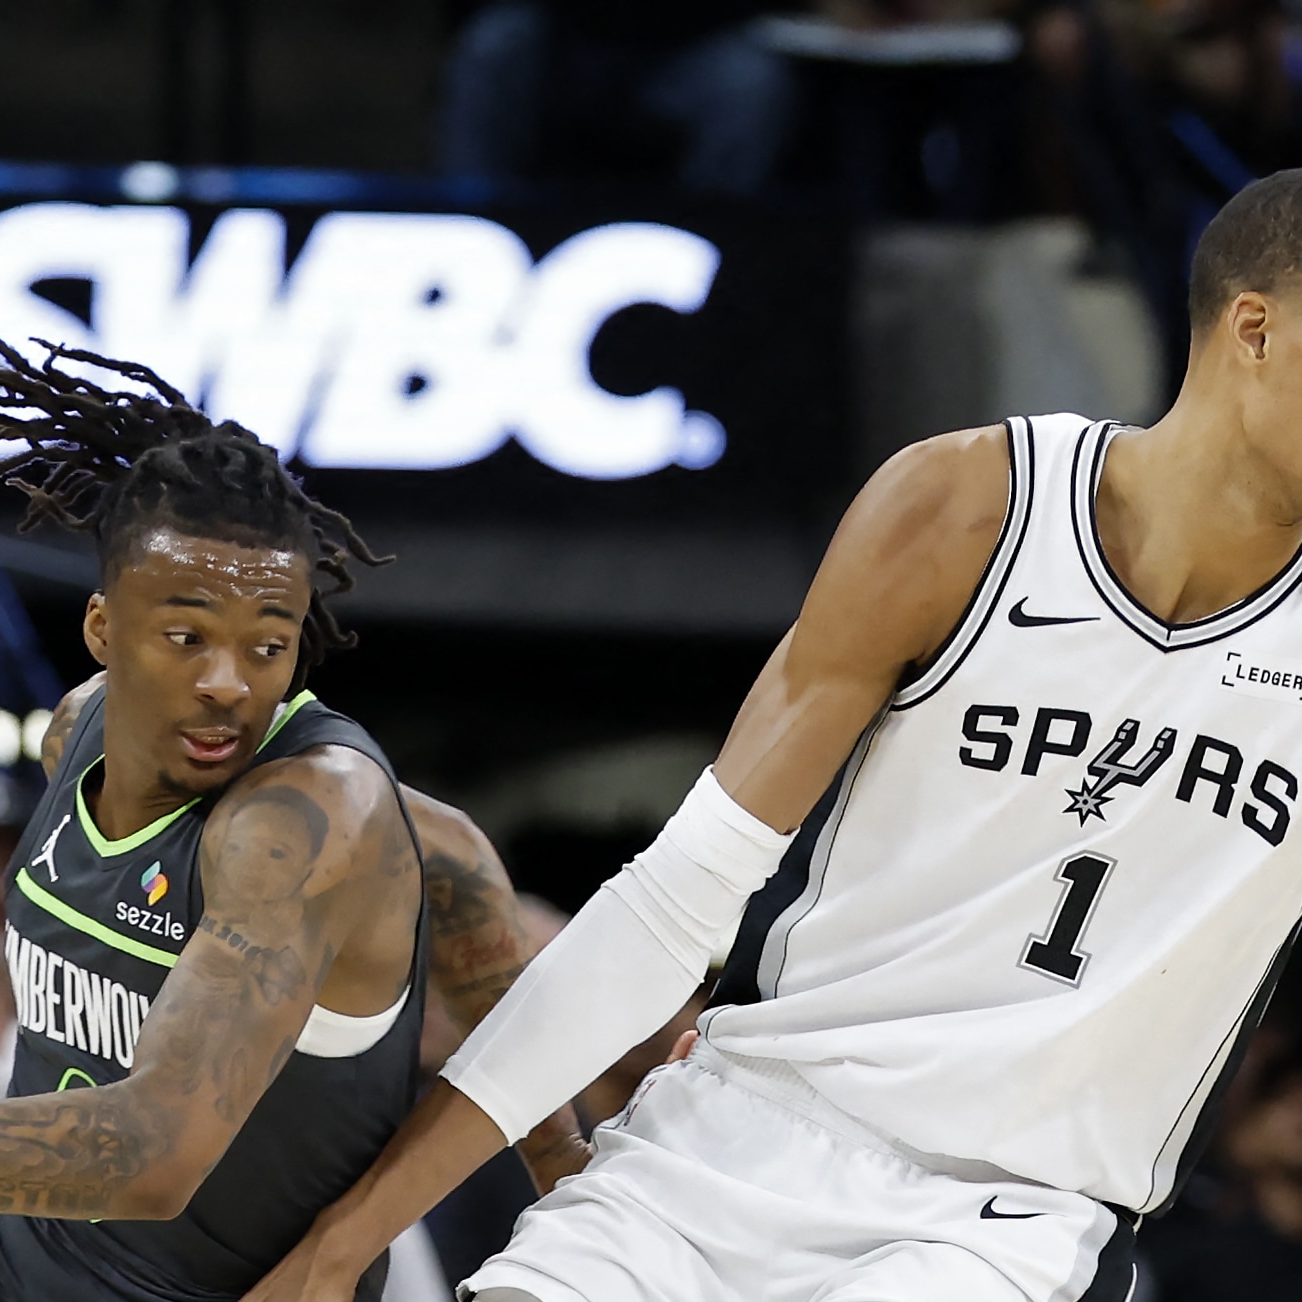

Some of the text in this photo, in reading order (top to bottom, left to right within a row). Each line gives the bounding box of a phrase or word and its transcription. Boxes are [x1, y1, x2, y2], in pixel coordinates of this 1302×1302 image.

[959, 704, 1298, 847] SPURS
[115, 900, 186, 941] sezzle
[1015, 850, 1118, 989] 1
